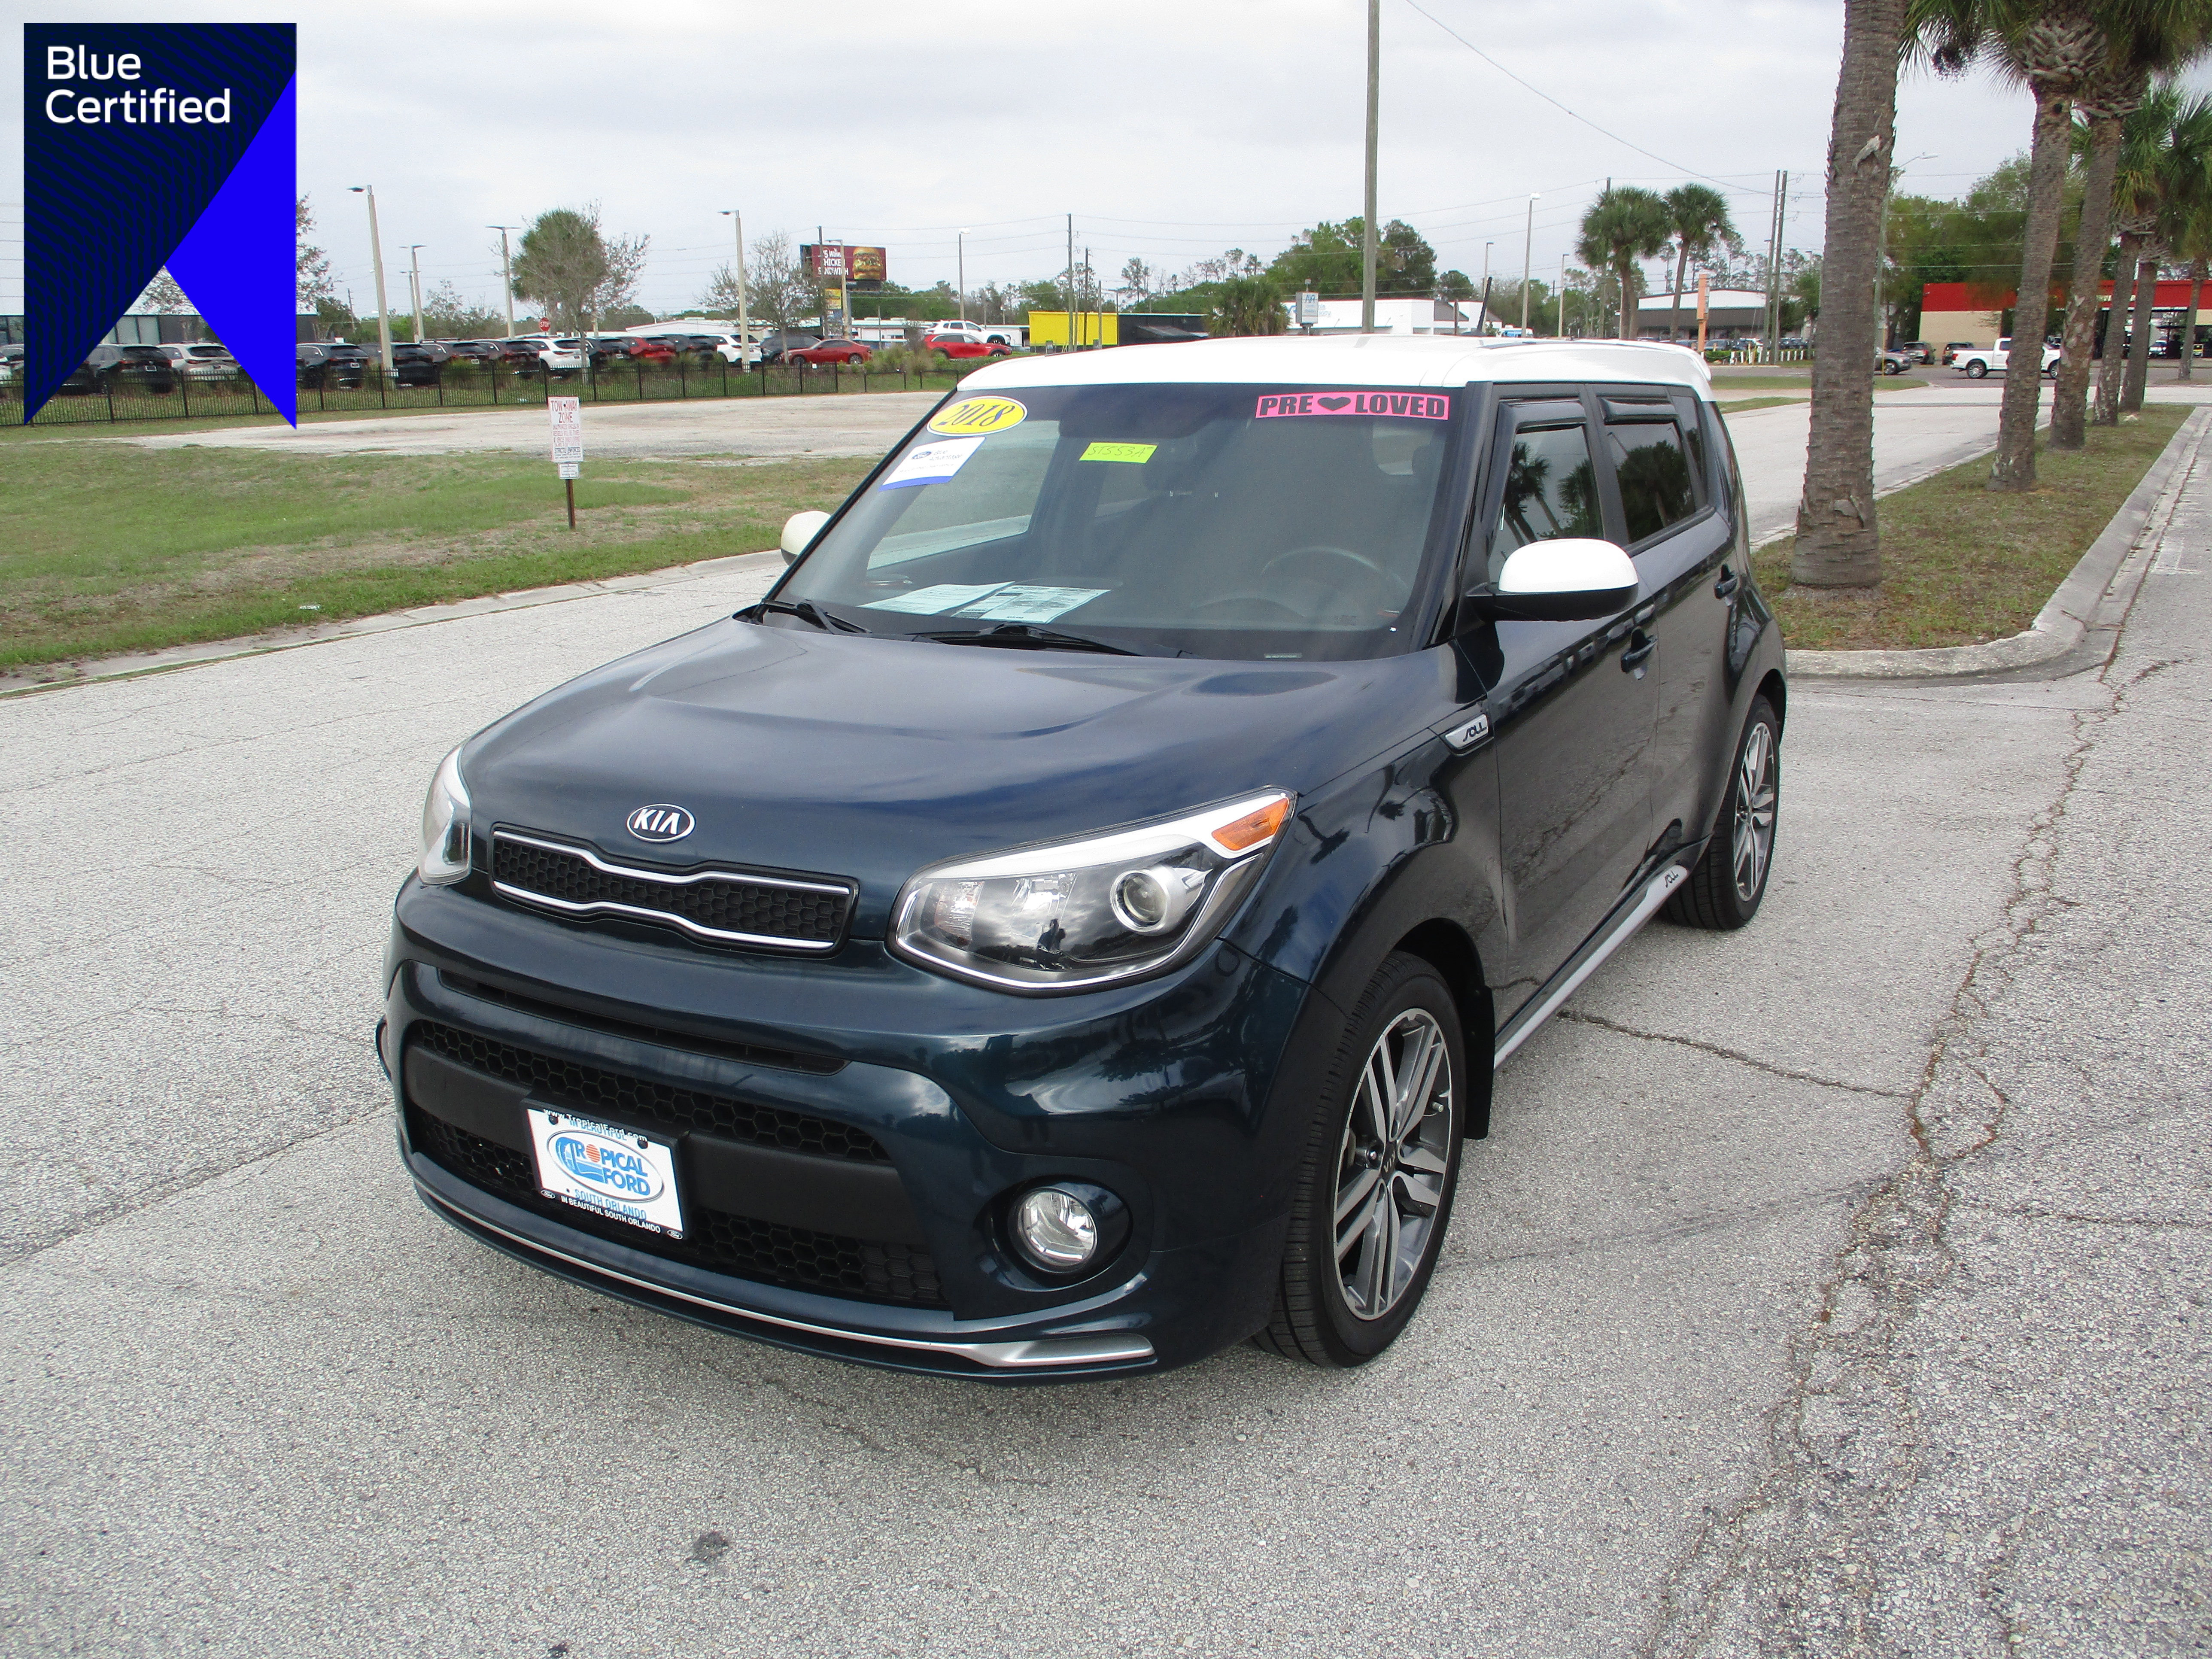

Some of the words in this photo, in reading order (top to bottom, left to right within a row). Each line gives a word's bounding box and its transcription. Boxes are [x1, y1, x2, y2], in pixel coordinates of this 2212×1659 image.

[817, 267, 849, 275] SNDWIH
[550, 400, 563, 412] TOW
[565, 400, 577, 411] AWAY
[559, 412, 573, 423] ZONE
[936, 404, 1016, 427] 2018
[1259, 395, 1314, 416] PRE
[1355, 394, 1446, 417] LOVED
[633, 808, 681, 835] KIA
[556, 1137, 649, 1178] TROPICAL
[602, 1168, 651, 1196] FORD
[569, 1197, 604, 1215] BEAUTIFUL
[605, 1209, 627, 1223] SOUTH
[628, 1216, 662, 1234] ORLANDO
[574, 1188, 602, 1205] SOUTH
[605, 1198, 647, 1221] ORLANDO
